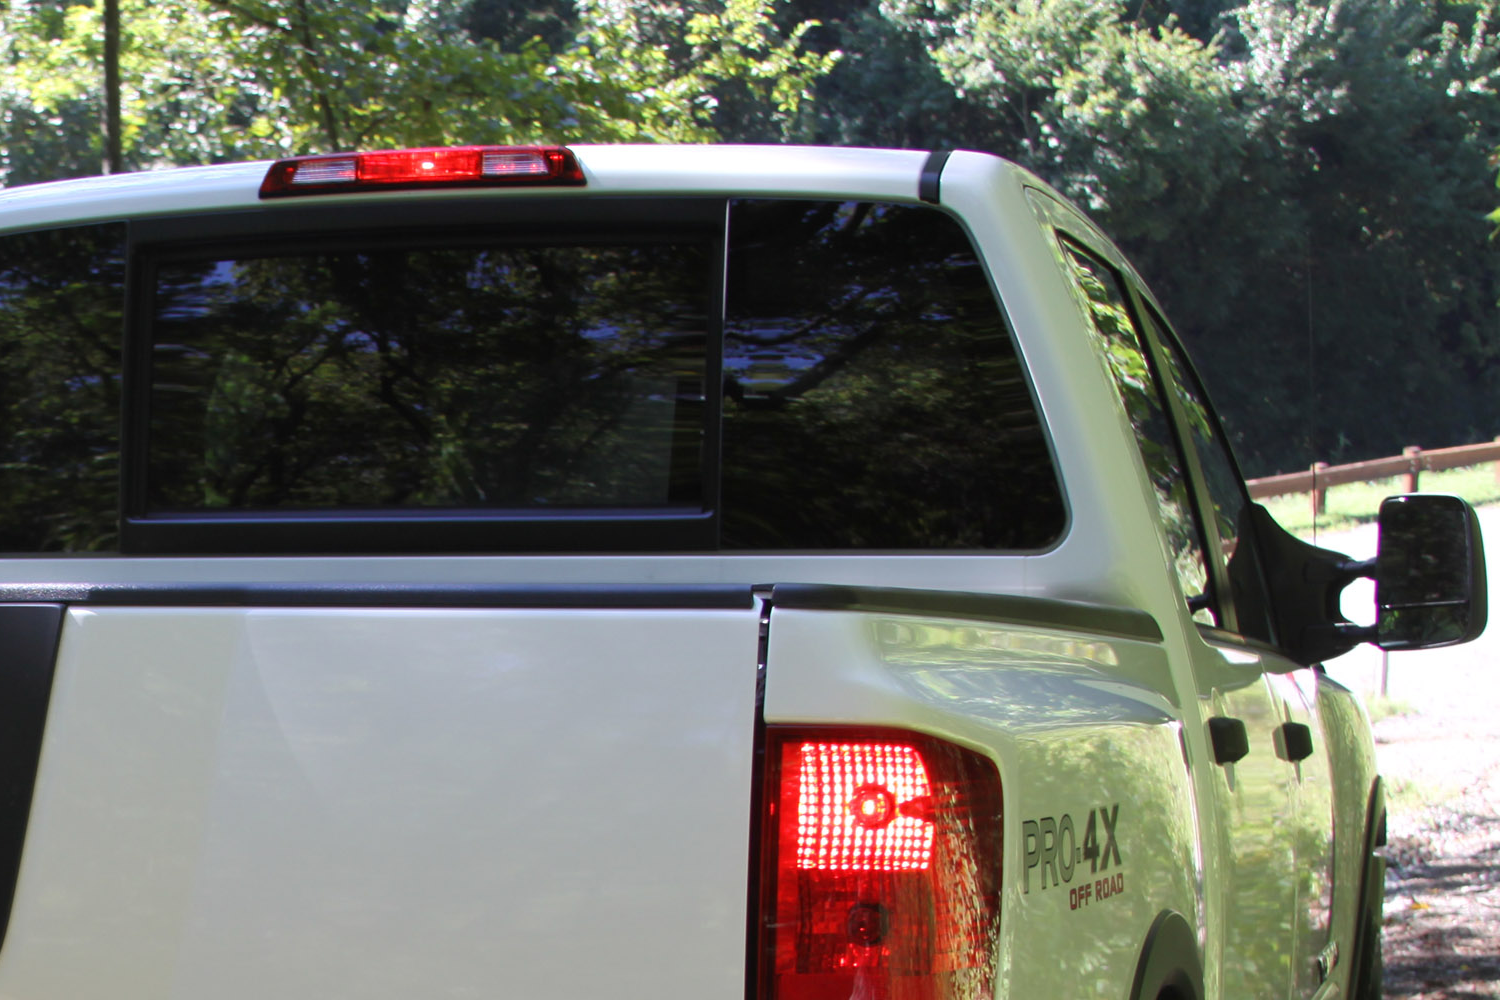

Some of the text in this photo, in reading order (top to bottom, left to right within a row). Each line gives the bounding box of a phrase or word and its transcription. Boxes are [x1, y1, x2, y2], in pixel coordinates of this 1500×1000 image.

[1021, 802, 1123, 895] PRO-4X
[1069, 872, 1124, 911] OFF ROAD
